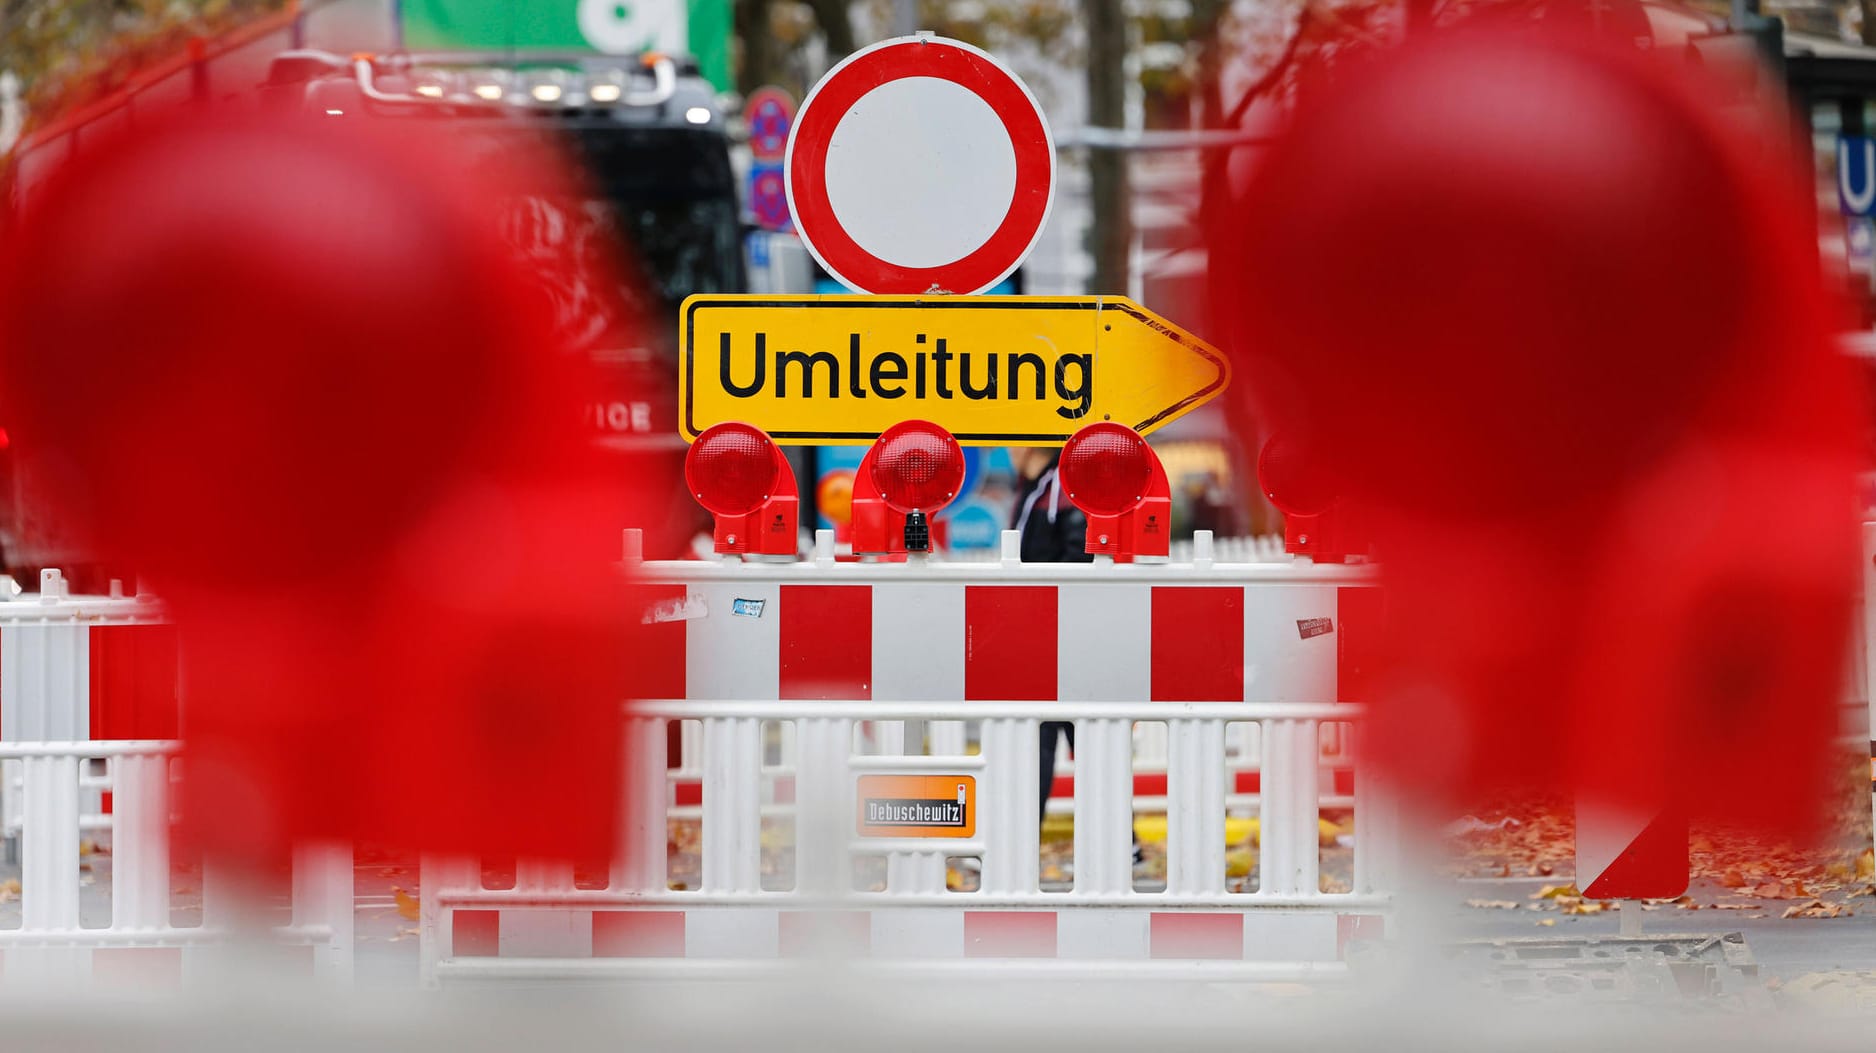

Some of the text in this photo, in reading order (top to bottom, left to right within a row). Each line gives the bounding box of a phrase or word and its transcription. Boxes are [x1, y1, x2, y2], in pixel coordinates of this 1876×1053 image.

[1840, 139, 1876, 214] U
[719, 332, 1093, 420] Umleitung
[868, 803, 959, 822] Debuschewitz
